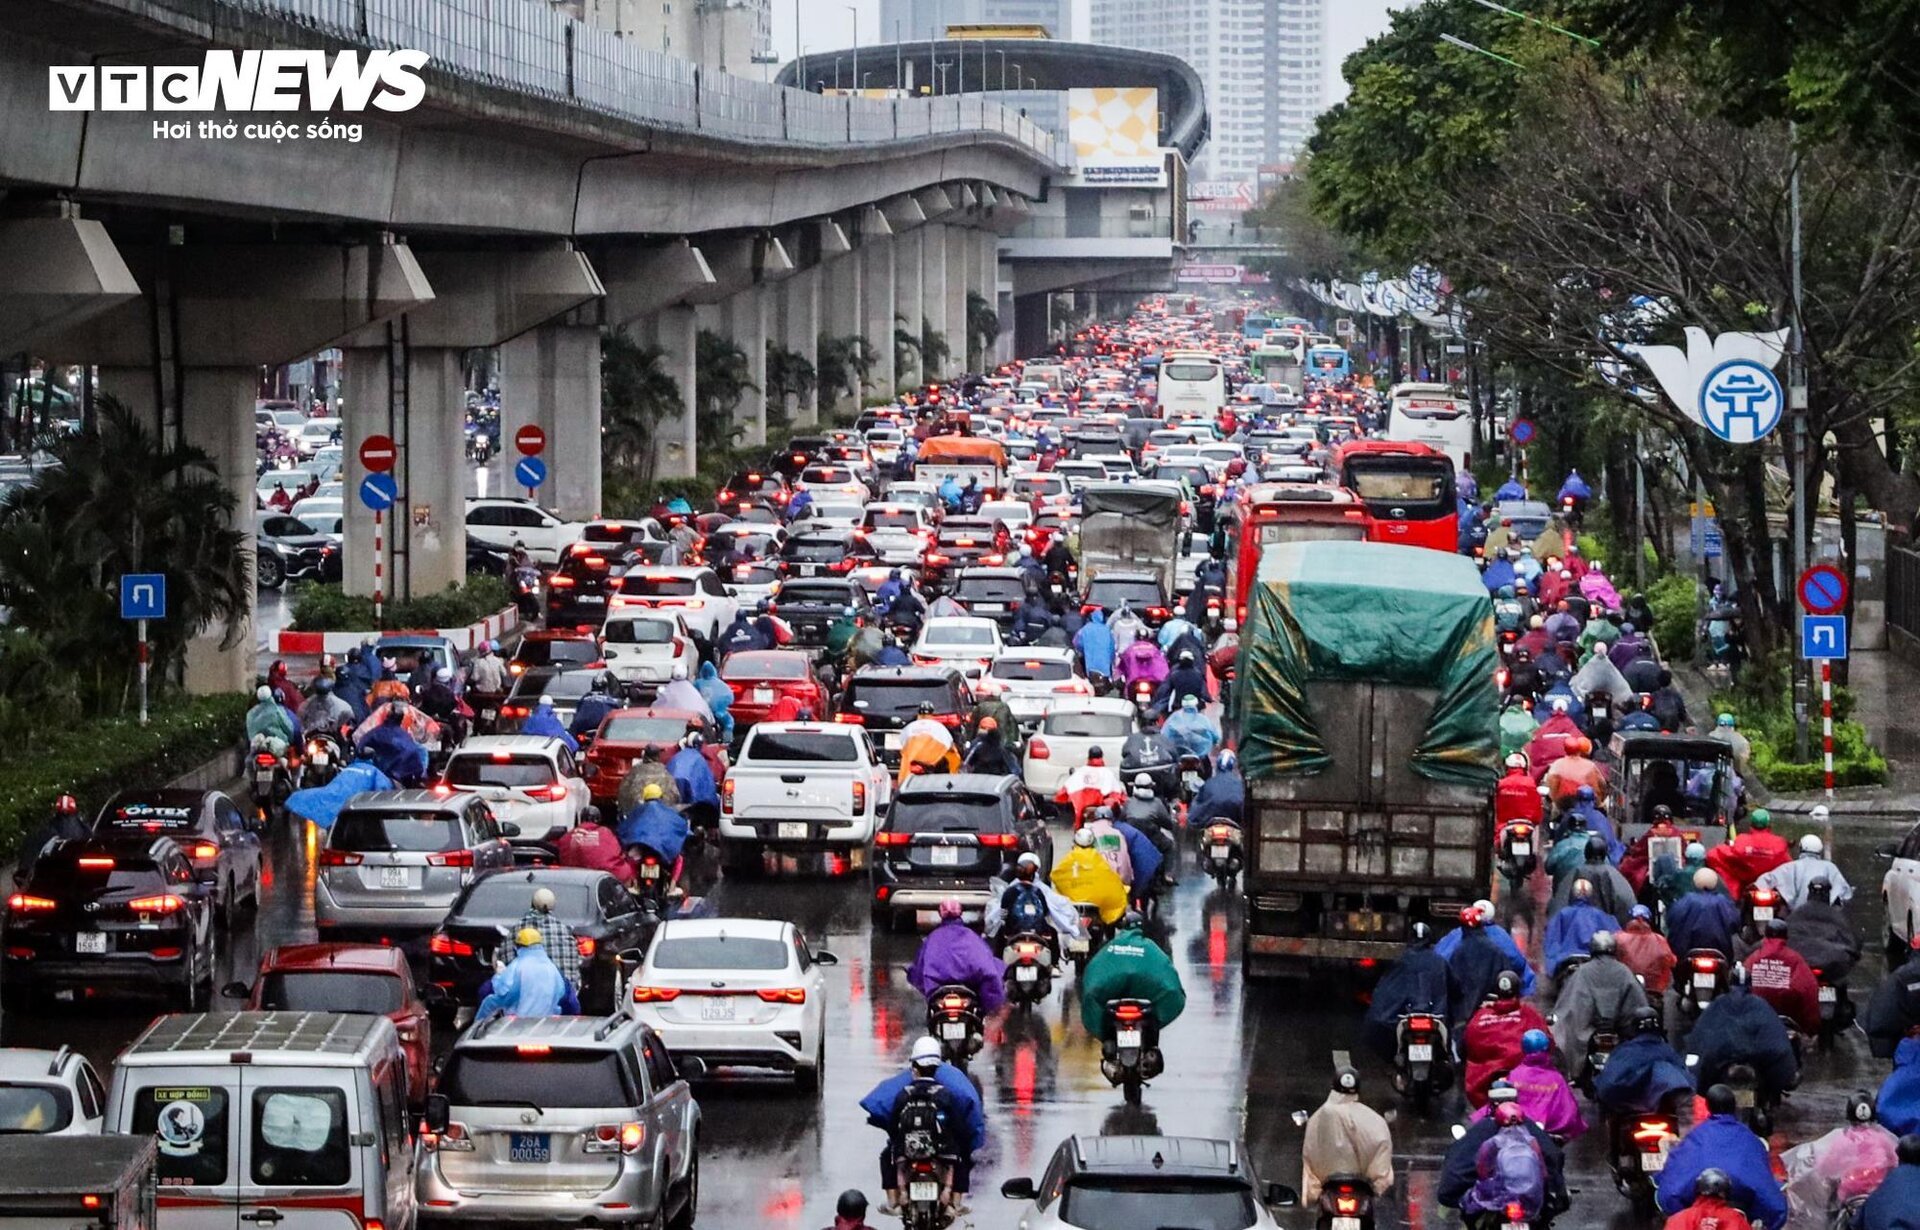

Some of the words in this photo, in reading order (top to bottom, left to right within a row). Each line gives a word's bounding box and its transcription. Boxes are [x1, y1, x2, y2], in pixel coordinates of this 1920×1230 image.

[124, 807, 191, 817] OPTEX
[158, 1091, 167, 1099] XE
[519, 1135, 541, 1148] 26A
[511, 1148, 549, 1161] 000.59
